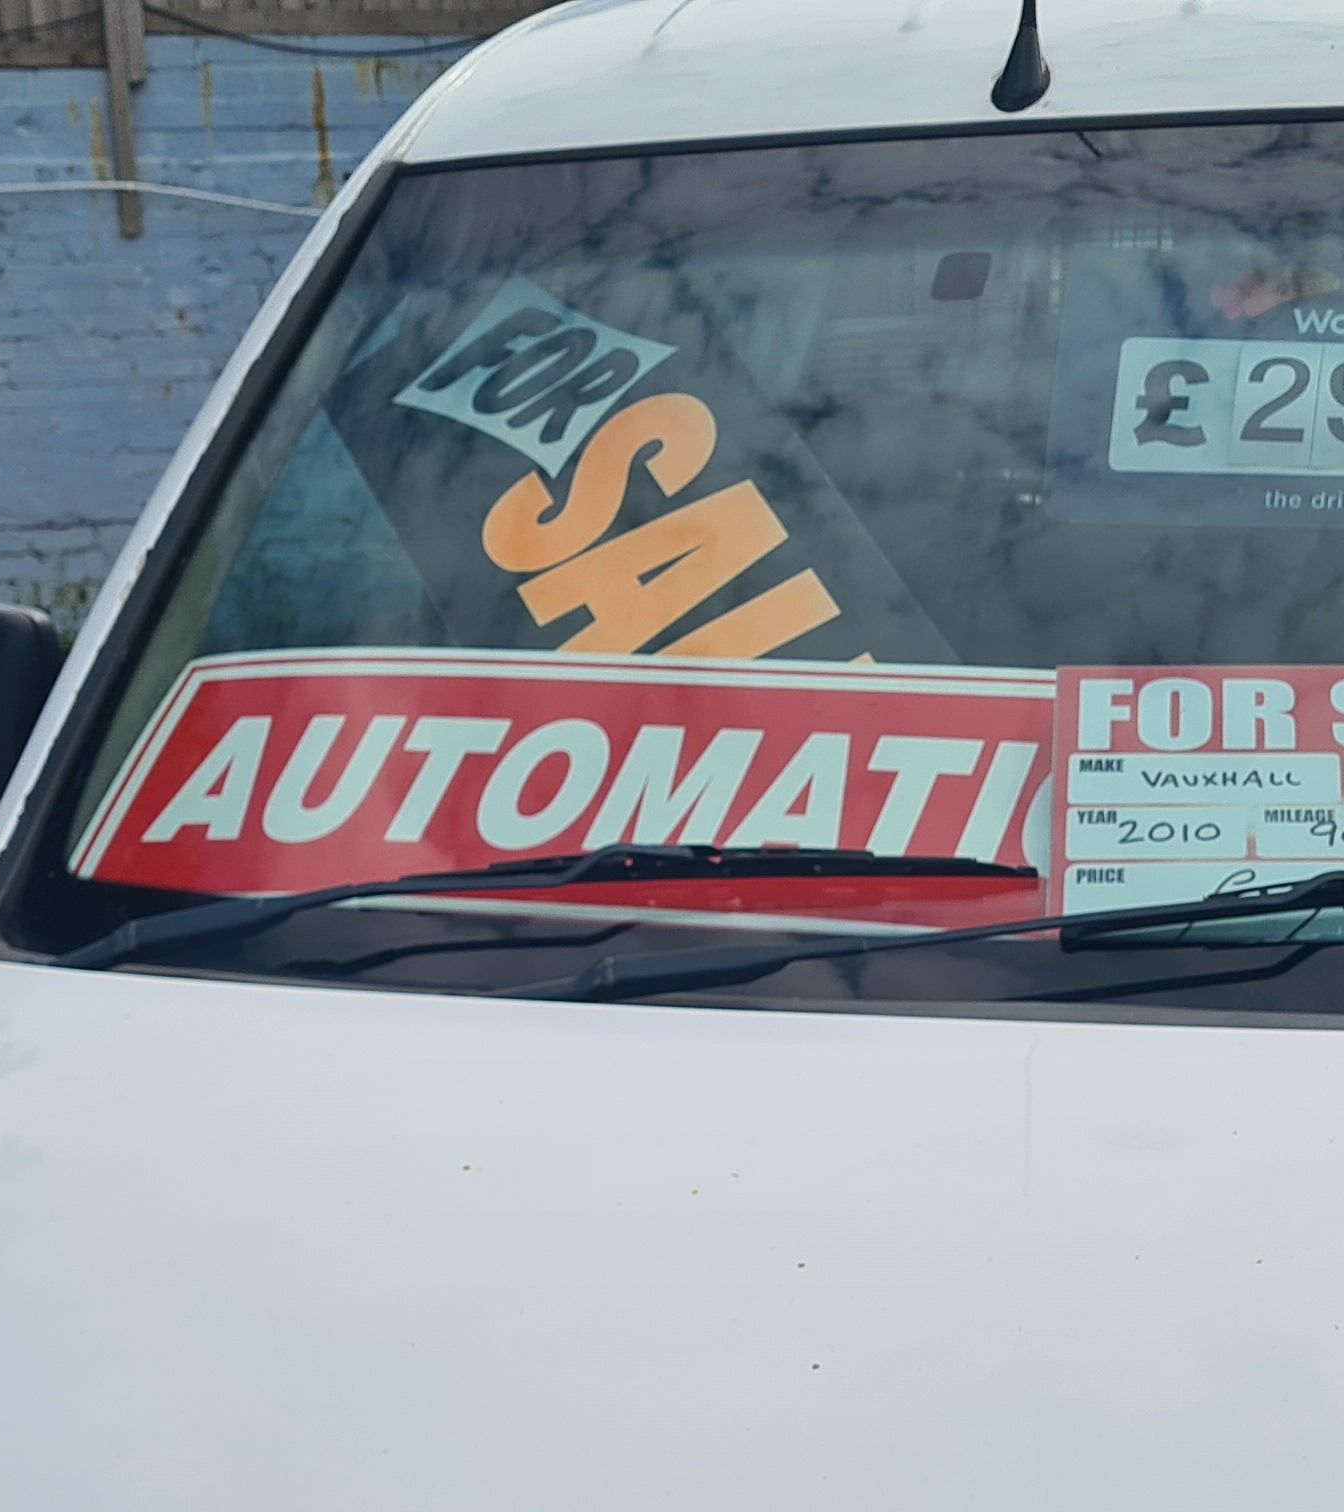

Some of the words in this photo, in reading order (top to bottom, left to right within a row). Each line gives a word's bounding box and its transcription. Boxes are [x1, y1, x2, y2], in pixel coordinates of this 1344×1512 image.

[417, 305, 641, 444] FOR
[1264, 490, 1302, 511] the
[1077, 677, 1296, 751] FOR
[1079, 758, 1124, 773] MAKE
[1140, 769, 1302, 789] VAUXHALL
[1077, 809, 1117, 824] YEAR
[1263, 808, 1336, 823] MILEAGE
[1117, 820, 1222, 845] 2010
[1076, 867, 1126, 884] PRICE
